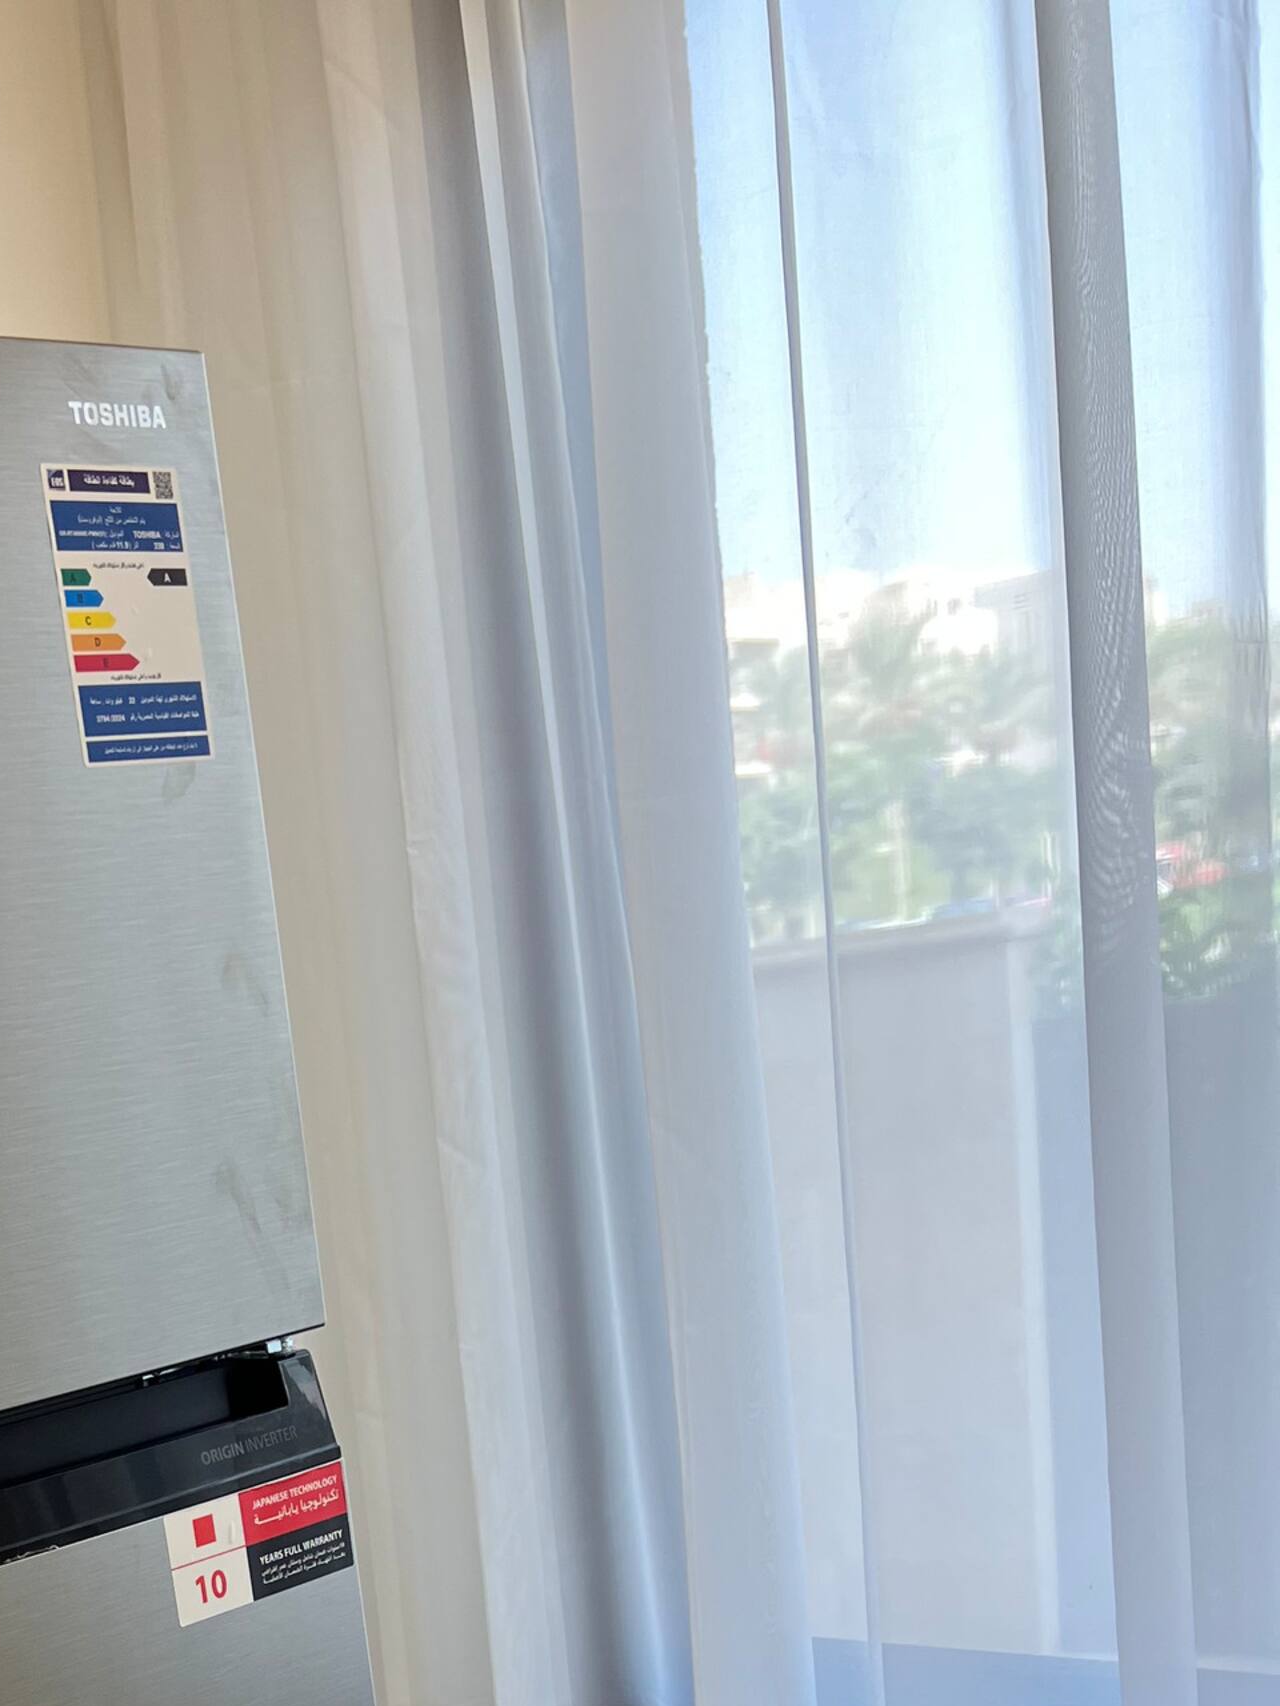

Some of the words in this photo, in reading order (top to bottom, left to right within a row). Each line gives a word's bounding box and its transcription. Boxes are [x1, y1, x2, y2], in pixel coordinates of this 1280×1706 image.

[68, 401, 167, 429] TOSHIBA
[133, 530, 161, 539] TOSHIBA
[70, 573, 77, 582] A
[163, 573, 172, 583] A
[85, 616, 91, 626] C
[94, 637, 101, 647] D
[200, 1441, 245, 1466] ORIGIN
[245, 1425, 297, 1454] INVERTER
[252, 1492, 289, 1511] JAPANESE
[290, 1475, 338, 1498] TECHNOLOGY
[300, 1488, 340, 1511] تكنولوجيا
[259, 1547, 283, 1565] YEARS
[284, 1542, 302, 1558] FULL
[303, 1529, 343, 1551] WARRANTY
[195, 1570, 228, 1603] 10
